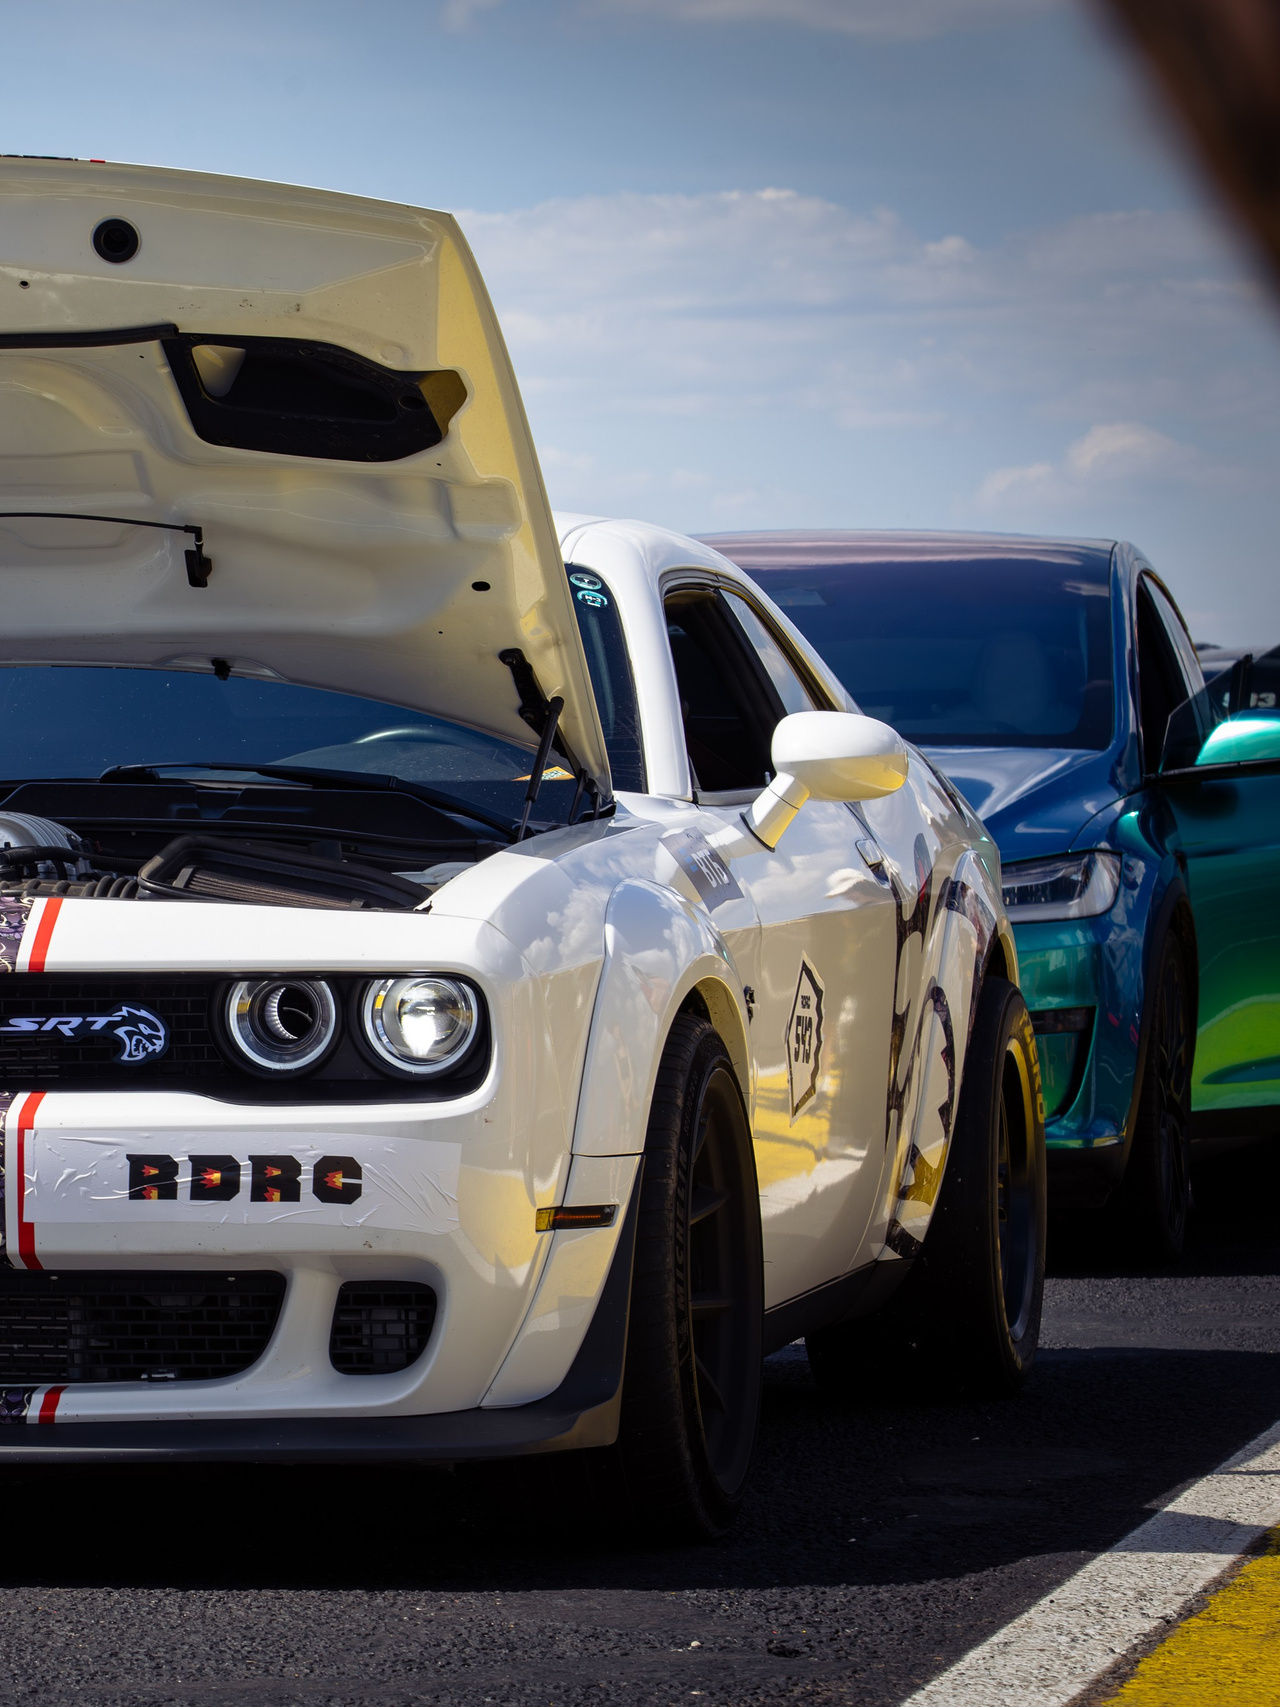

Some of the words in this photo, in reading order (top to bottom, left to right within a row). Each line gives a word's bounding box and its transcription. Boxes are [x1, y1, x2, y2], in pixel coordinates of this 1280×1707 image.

[793, 1014, 813, 1064] 543
[125, 1153, 363, 1206] RDRC
[674, 1144, 689, 1311] MICHELIN
